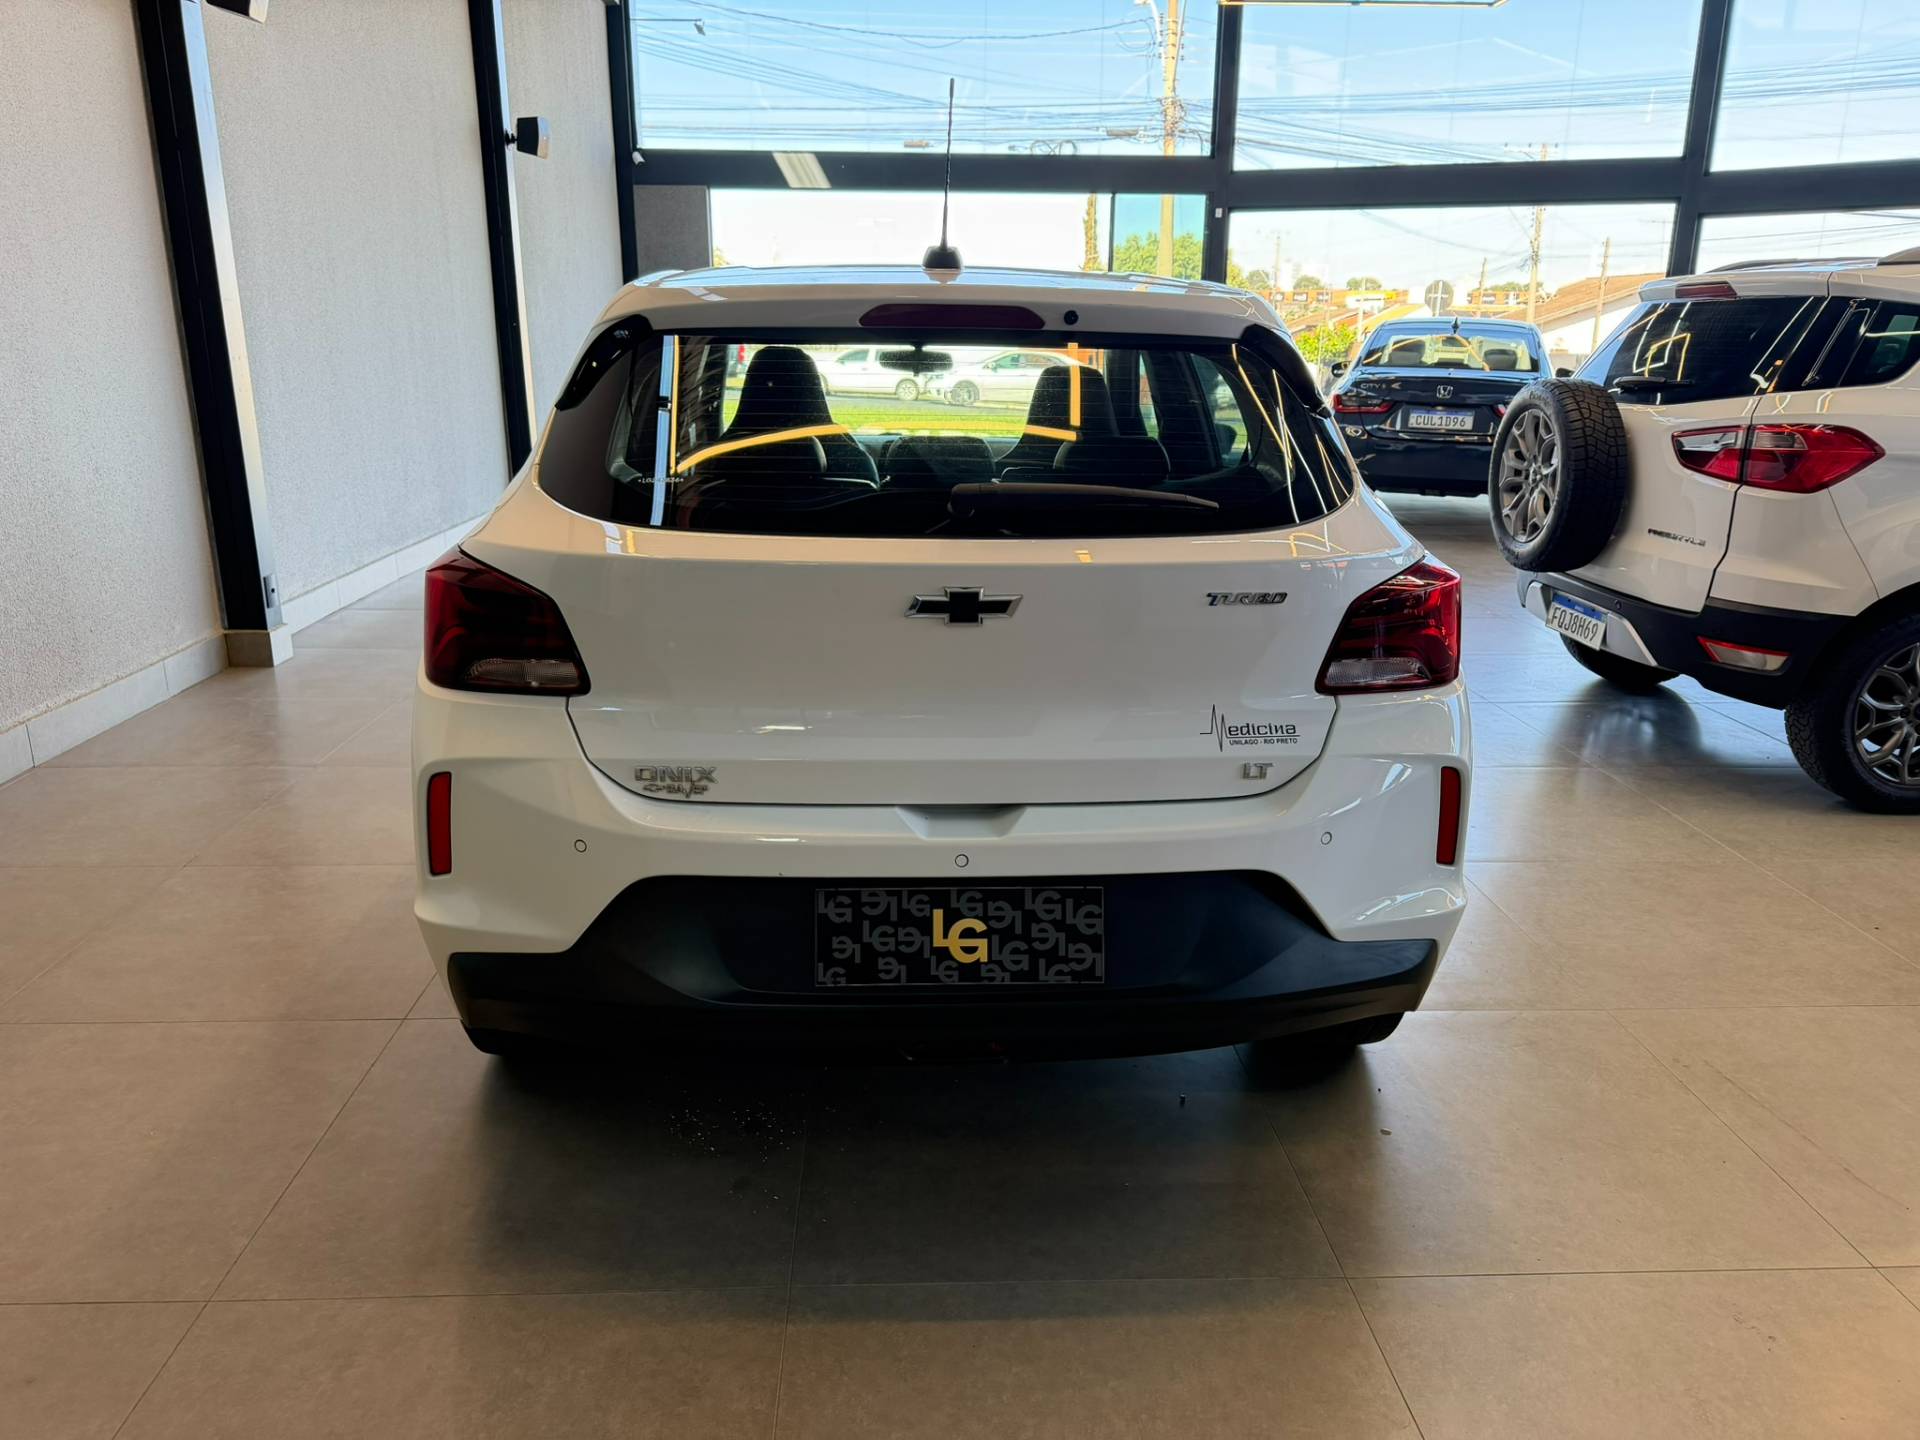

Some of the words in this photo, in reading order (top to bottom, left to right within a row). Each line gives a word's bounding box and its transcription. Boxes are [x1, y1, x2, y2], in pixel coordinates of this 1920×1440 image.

[1415, 415, 1466, 427] CUL1D96
[1206, 592, 1288, 606] TURBO
[1551, 607, 1599, 642] FQJ8H69
[1210, 703, 1298, 752] Medicina
[1276, 737, 1298, 745] PRETO
[634, 765, 719, 784] ONIX
[1242, 762, 1274, 780] LT
[932, 908, 989, 964] LG
